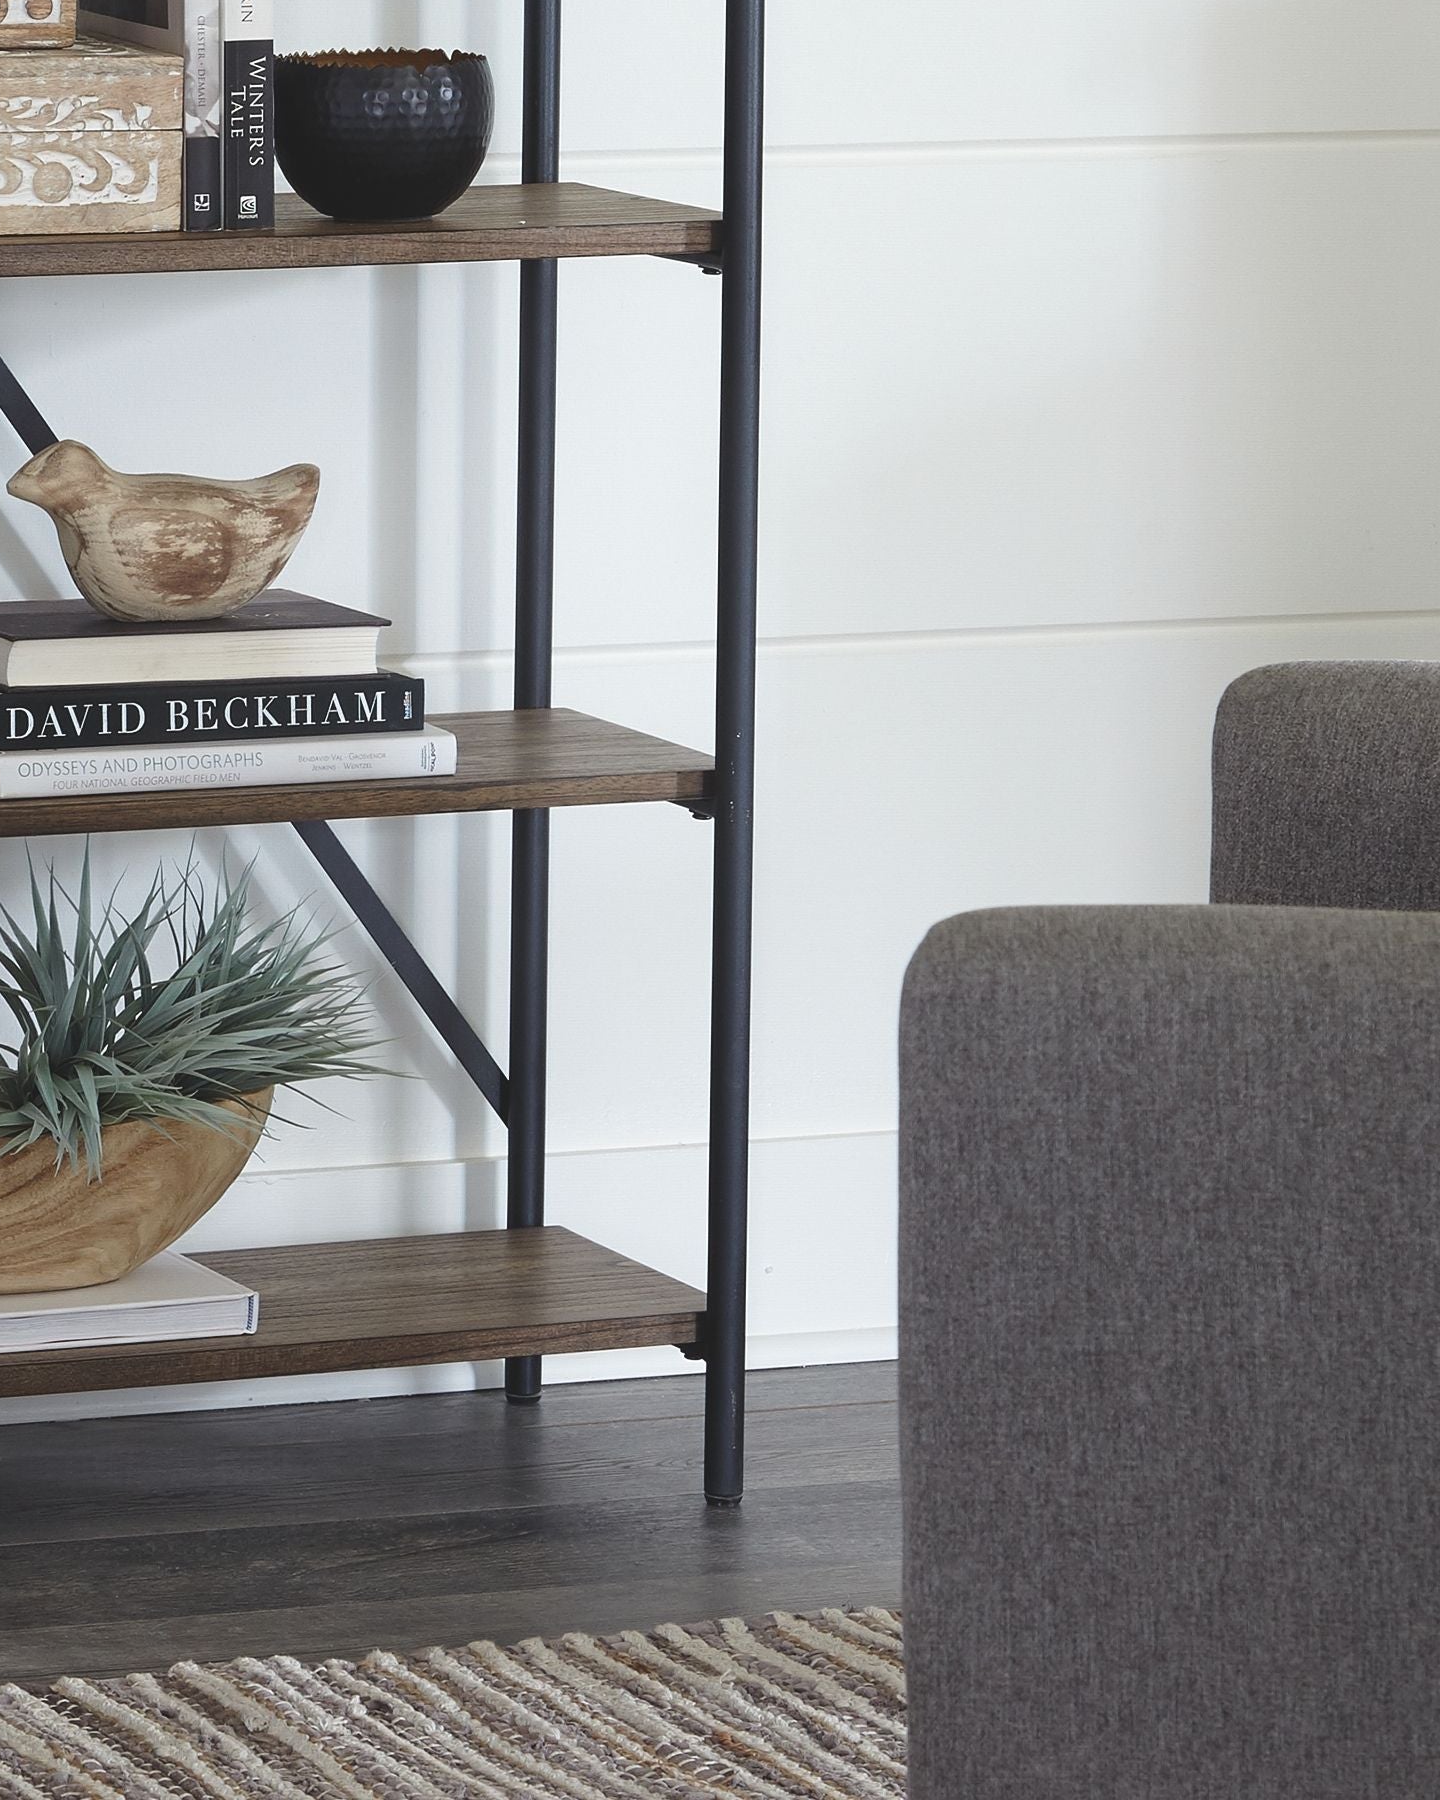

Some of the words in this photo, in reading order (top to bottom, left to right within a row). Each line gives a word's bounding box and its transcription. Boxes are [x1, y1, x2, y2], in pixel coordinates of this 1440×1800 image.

[196, 15, 206, 60] CHESTER
[230, 85, 247, 138] TALE
[248, 56, 267, 167] WINTER'S
[5, 702, 146, 740] DAVID
[165, 690, 387, 733] BECKHAM
[18, 759, 98, 778] ODYSSEYS
[102, 757, 139, 774] AND
[143, 751, 264, 772] PHOTOGRAPHS
[311, 764, 337, 772] JENKINS
[343, 762, 373, 770] WENTZEL
[348, 752, 387, 760] GROSVENOR
[52, 779, 80, 791] FOUR
[80, 777, 129, 789] NATIONAL
[130, 774, 191, 787] GEOGRAPHIC
[192, 773, 218, 784] FIELD
[219, 772, 241, 783] MEN
